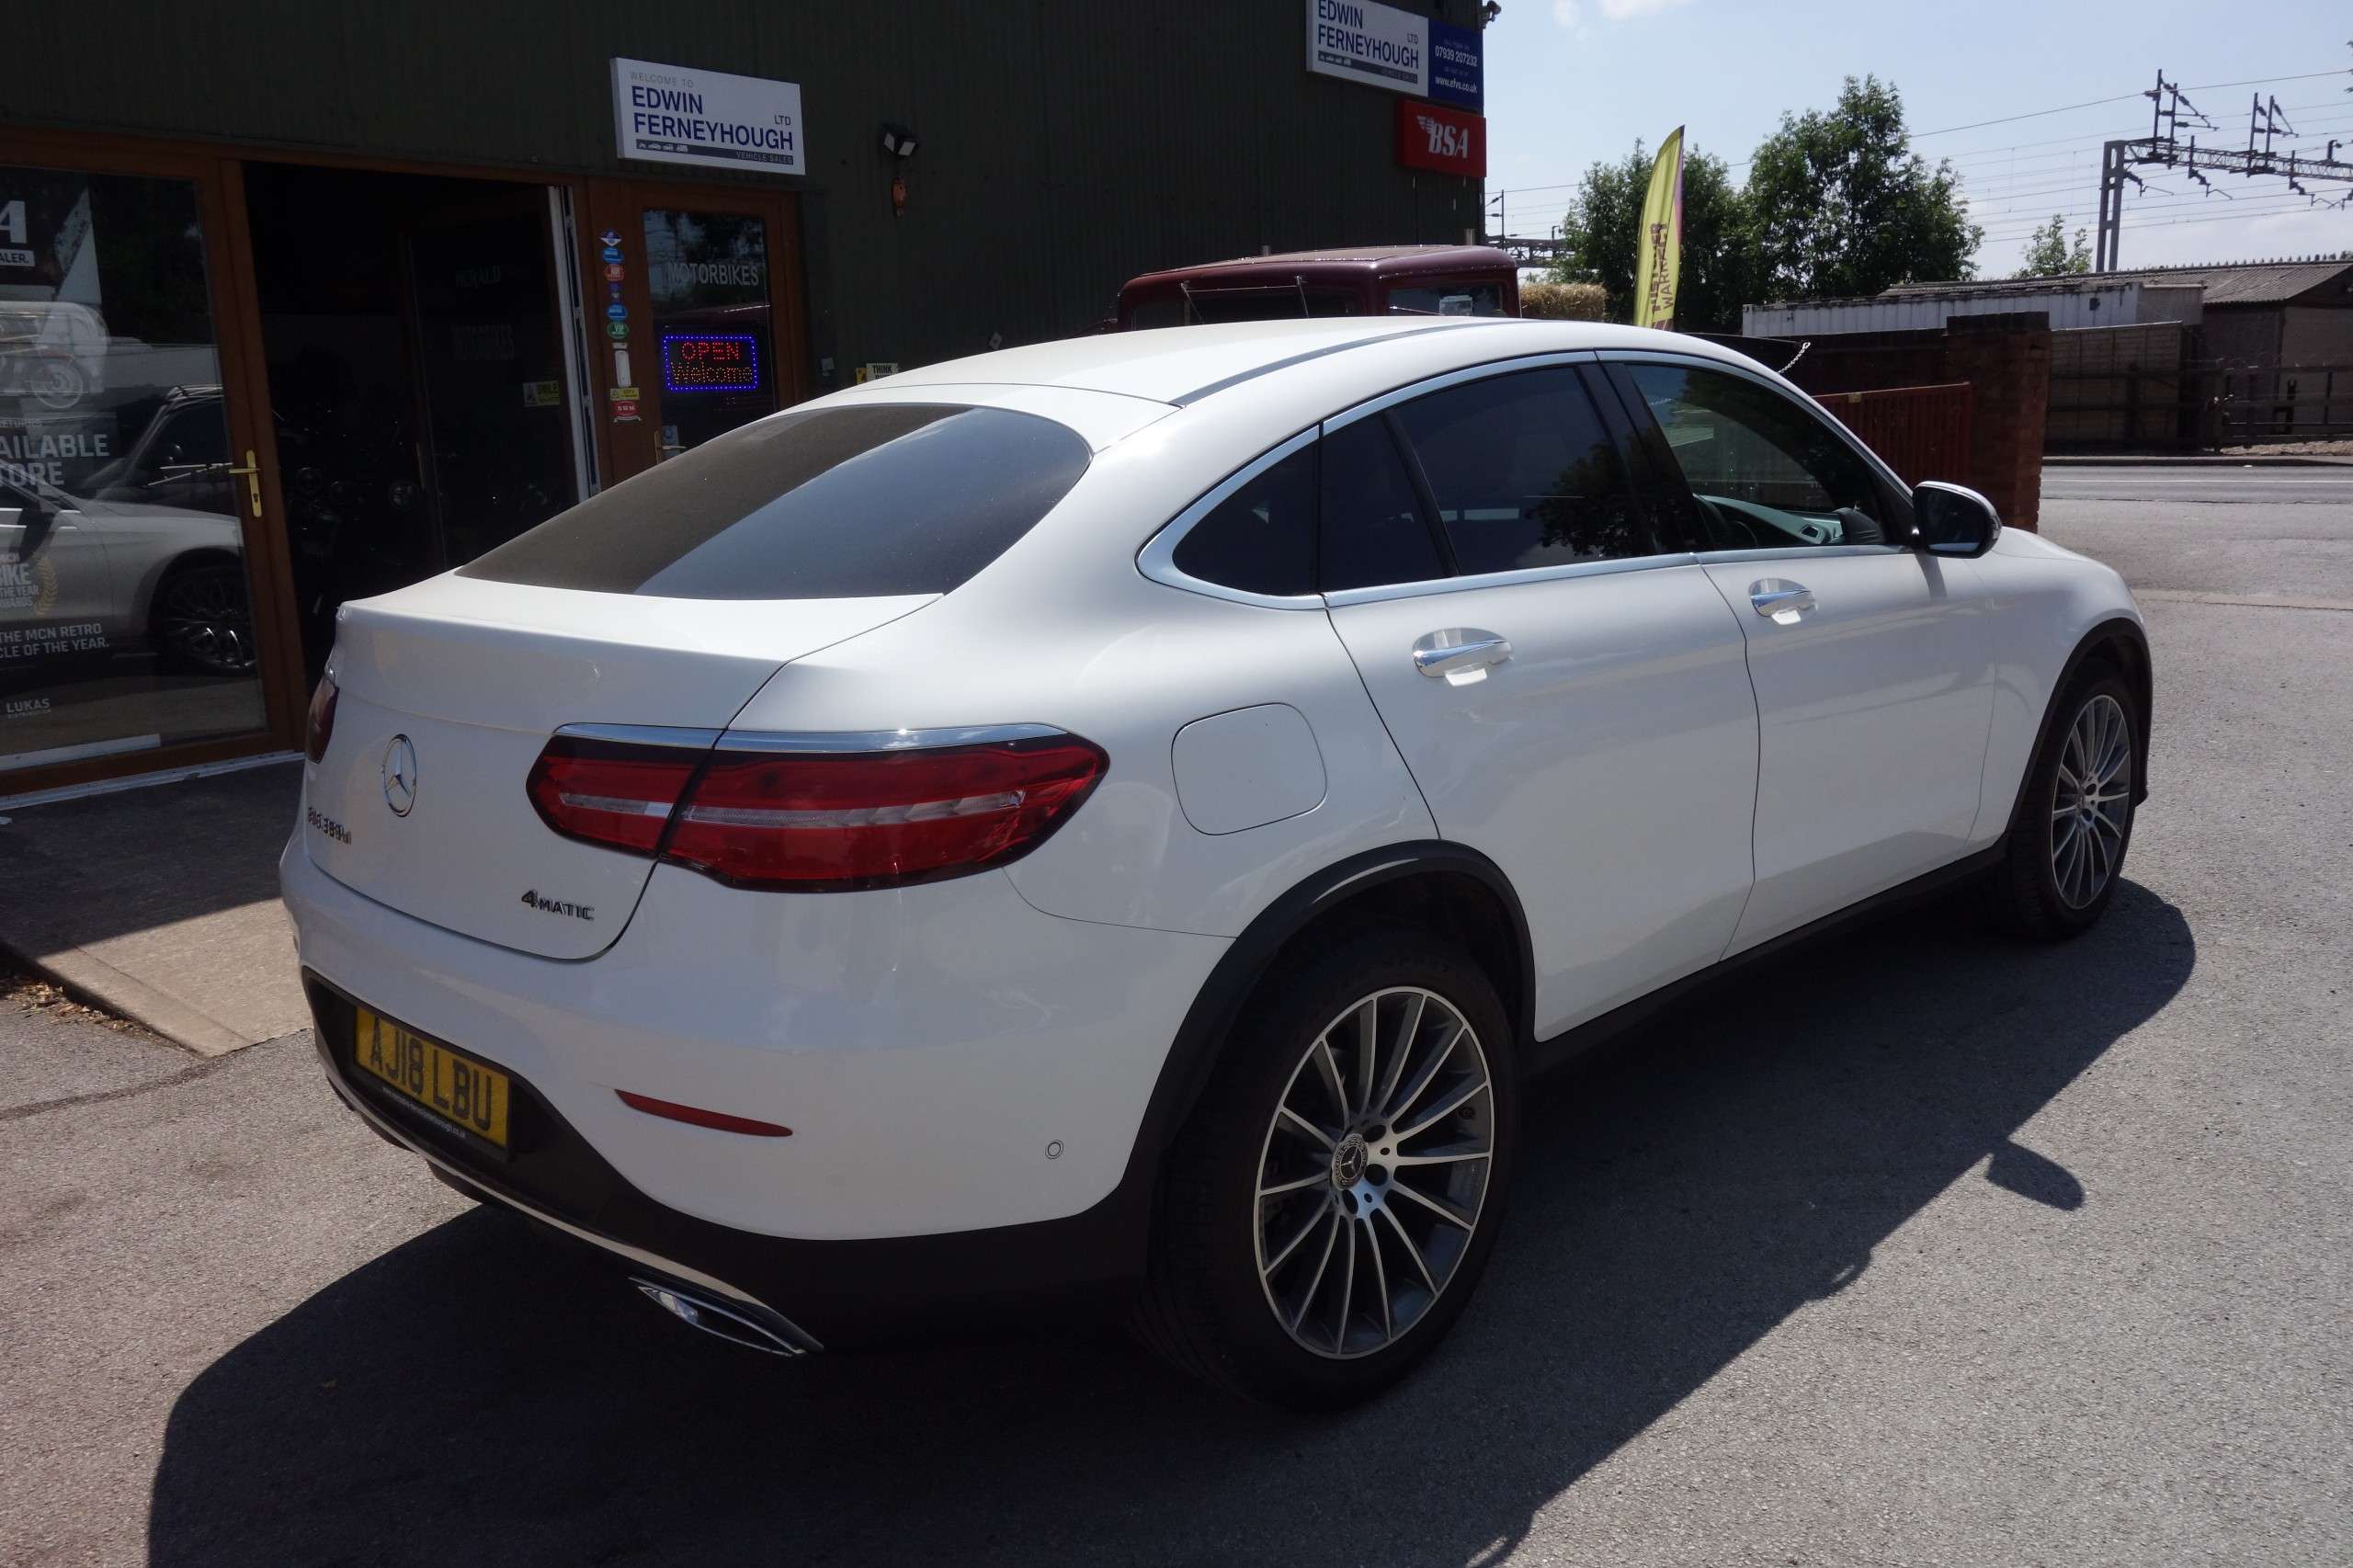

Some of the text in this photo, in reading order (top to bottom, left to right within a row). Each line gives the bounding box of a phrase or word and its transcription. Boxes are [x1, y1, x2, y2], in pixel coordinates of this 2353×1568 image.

[1318, 0, 1363, 29] EDWIN
[1318, 24, 1419, 69] FERNEYHOUGH
[631, 72, 693, 89] WELCOME TO
[631, 85, 703, 115] EDWIN
[633, 113, 793, 151] FERNEYHOUGH
[773, 114, 791, 126] LTD
[1427, 122, 1469, 159] BSA
[667, 262, 759, 287] MOTORBIKES
[681, 341, 739, 361] OPEN
[25, 628, 57, 642] MCN
[60, 623, 103, 638] RETRO
[23, 643, 41, 656] OF
[42, 641, 71, 655] THE
[6, 698, 51, 712] LUKAS
[521, 890, 595, 920] 4MATIC
[432, 1048, 491, 1131] LBU
